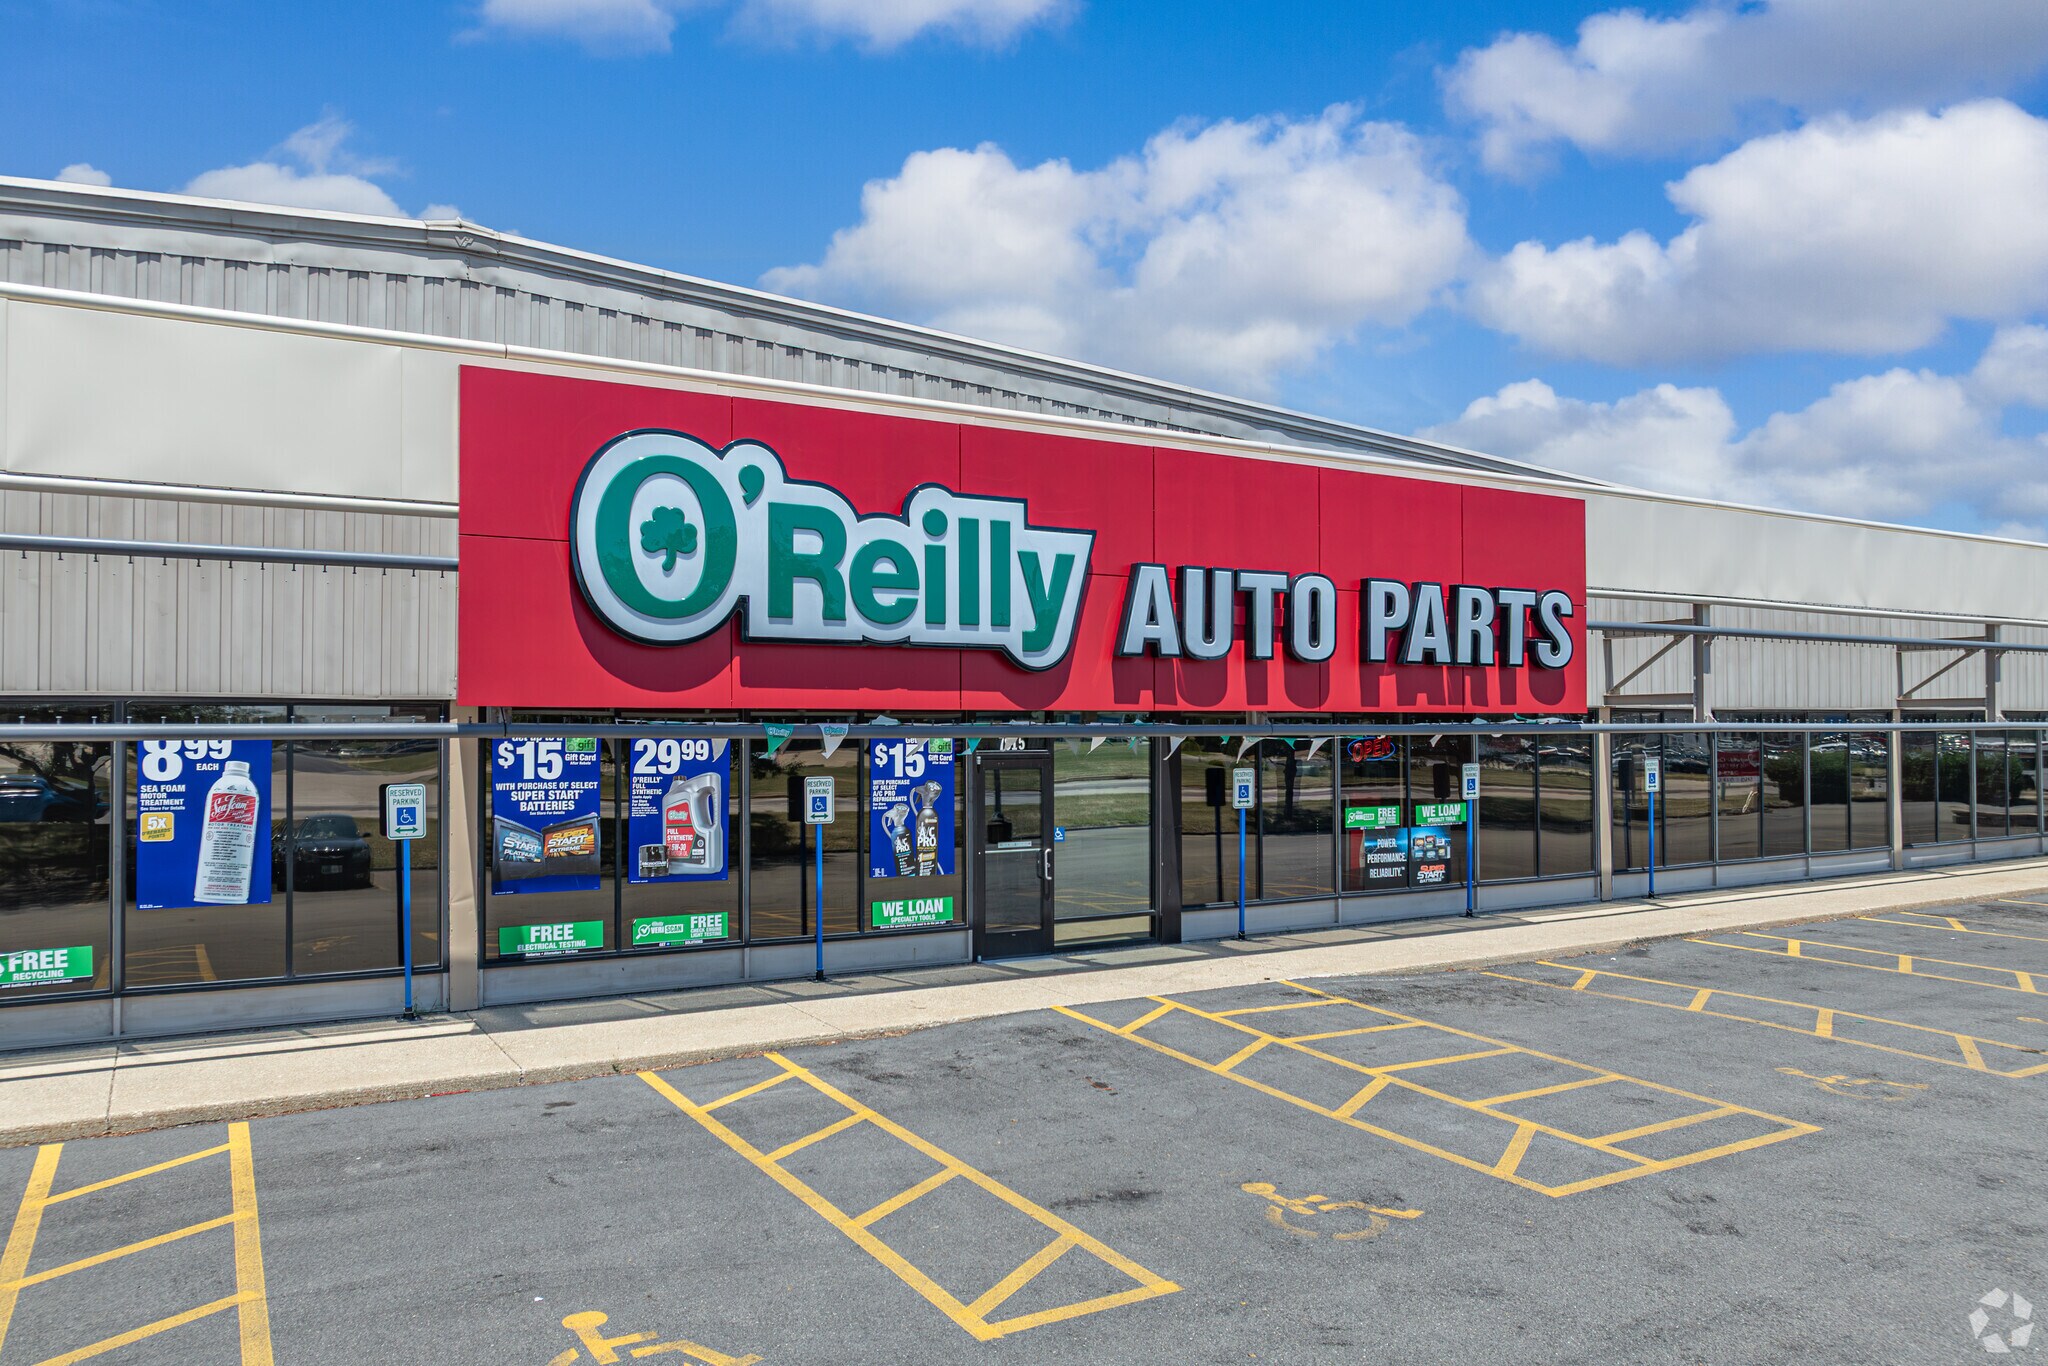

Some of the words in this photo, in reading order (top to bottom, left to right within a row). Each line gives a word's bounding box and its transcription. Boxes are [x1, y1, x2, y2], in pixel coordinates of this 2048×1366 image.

[595, 454, 1076, 653] O'Reilly
[1118, 562, 1338, 664] AUTO
[1360, 577, 1575, 669] PARTS
[1352, 735, 1392, 763] OPEN
[497, 740, 564, 781] $15
[564, 753, 579, 762] Gift
[579, 753, 597, 762] Card
[874, 742, 926, 778] $15
[939, 754, 953, 762] Card
[195, 762, 220, 771] EACH
[140, 784, 159, 793] SEA
[160, 784, 186, 793] FOAM
[495, 782, 516, 791] WITH
[517, 782, 558, 790] PURCHASE
[558, 782, 569, 790] OF
[570, 781, 599, 790] SELECT
[140, 792, 168, 800] MOTOR
[390, 788, 422, 796] RESERVED
[510, 791, 546, 802] SUPER
[140, 798, 185, 807] TREATMENT
[392, 797, 420, 805] PARKING
[519, 800, 576, 812] BATTERIES
[211, 797, 229, 819] Sea
[1377, 807, 1397, 818] FREE
[1421, 805, 1436, 818] WE
[1438, 803, 1461, 816] LOAN
[147, 815, 168, 830] 5x
[552, 827, 590, 840] SUPER
[502, 836, 540, 853] START
[917, 836, 937, 847] PRO
[1376, 838, 1398, 849] POWER.
[503, 848, 536, 859] PLATINUM
[549, 845, 582, 853] EXTREME
[896, 843, 911, 854] PRO
[1367, 852, 1408, 864] PERFORMANCE.
[1420, 864, 1446, 872] SUPER
[1416, 870, 1446, 880] START
[881, 900, 905, 918] WE
[907, 897, 944, 916] LOAN
[690, 914, 722, 928] FREE
[890, 915, 919, 924] SPECIALTY
[918, 913, 936, 922] TOOLS
[530, 923, 574, 943] FREE
[665, 924, 684, 933] SCAN
[516, 942, 558, 952] ELECTRICAL
[559, 939, 587, 949] TESTING
[8, 949, 69, 973] FREE
[12, 969, 65, 982] RECYCLING
